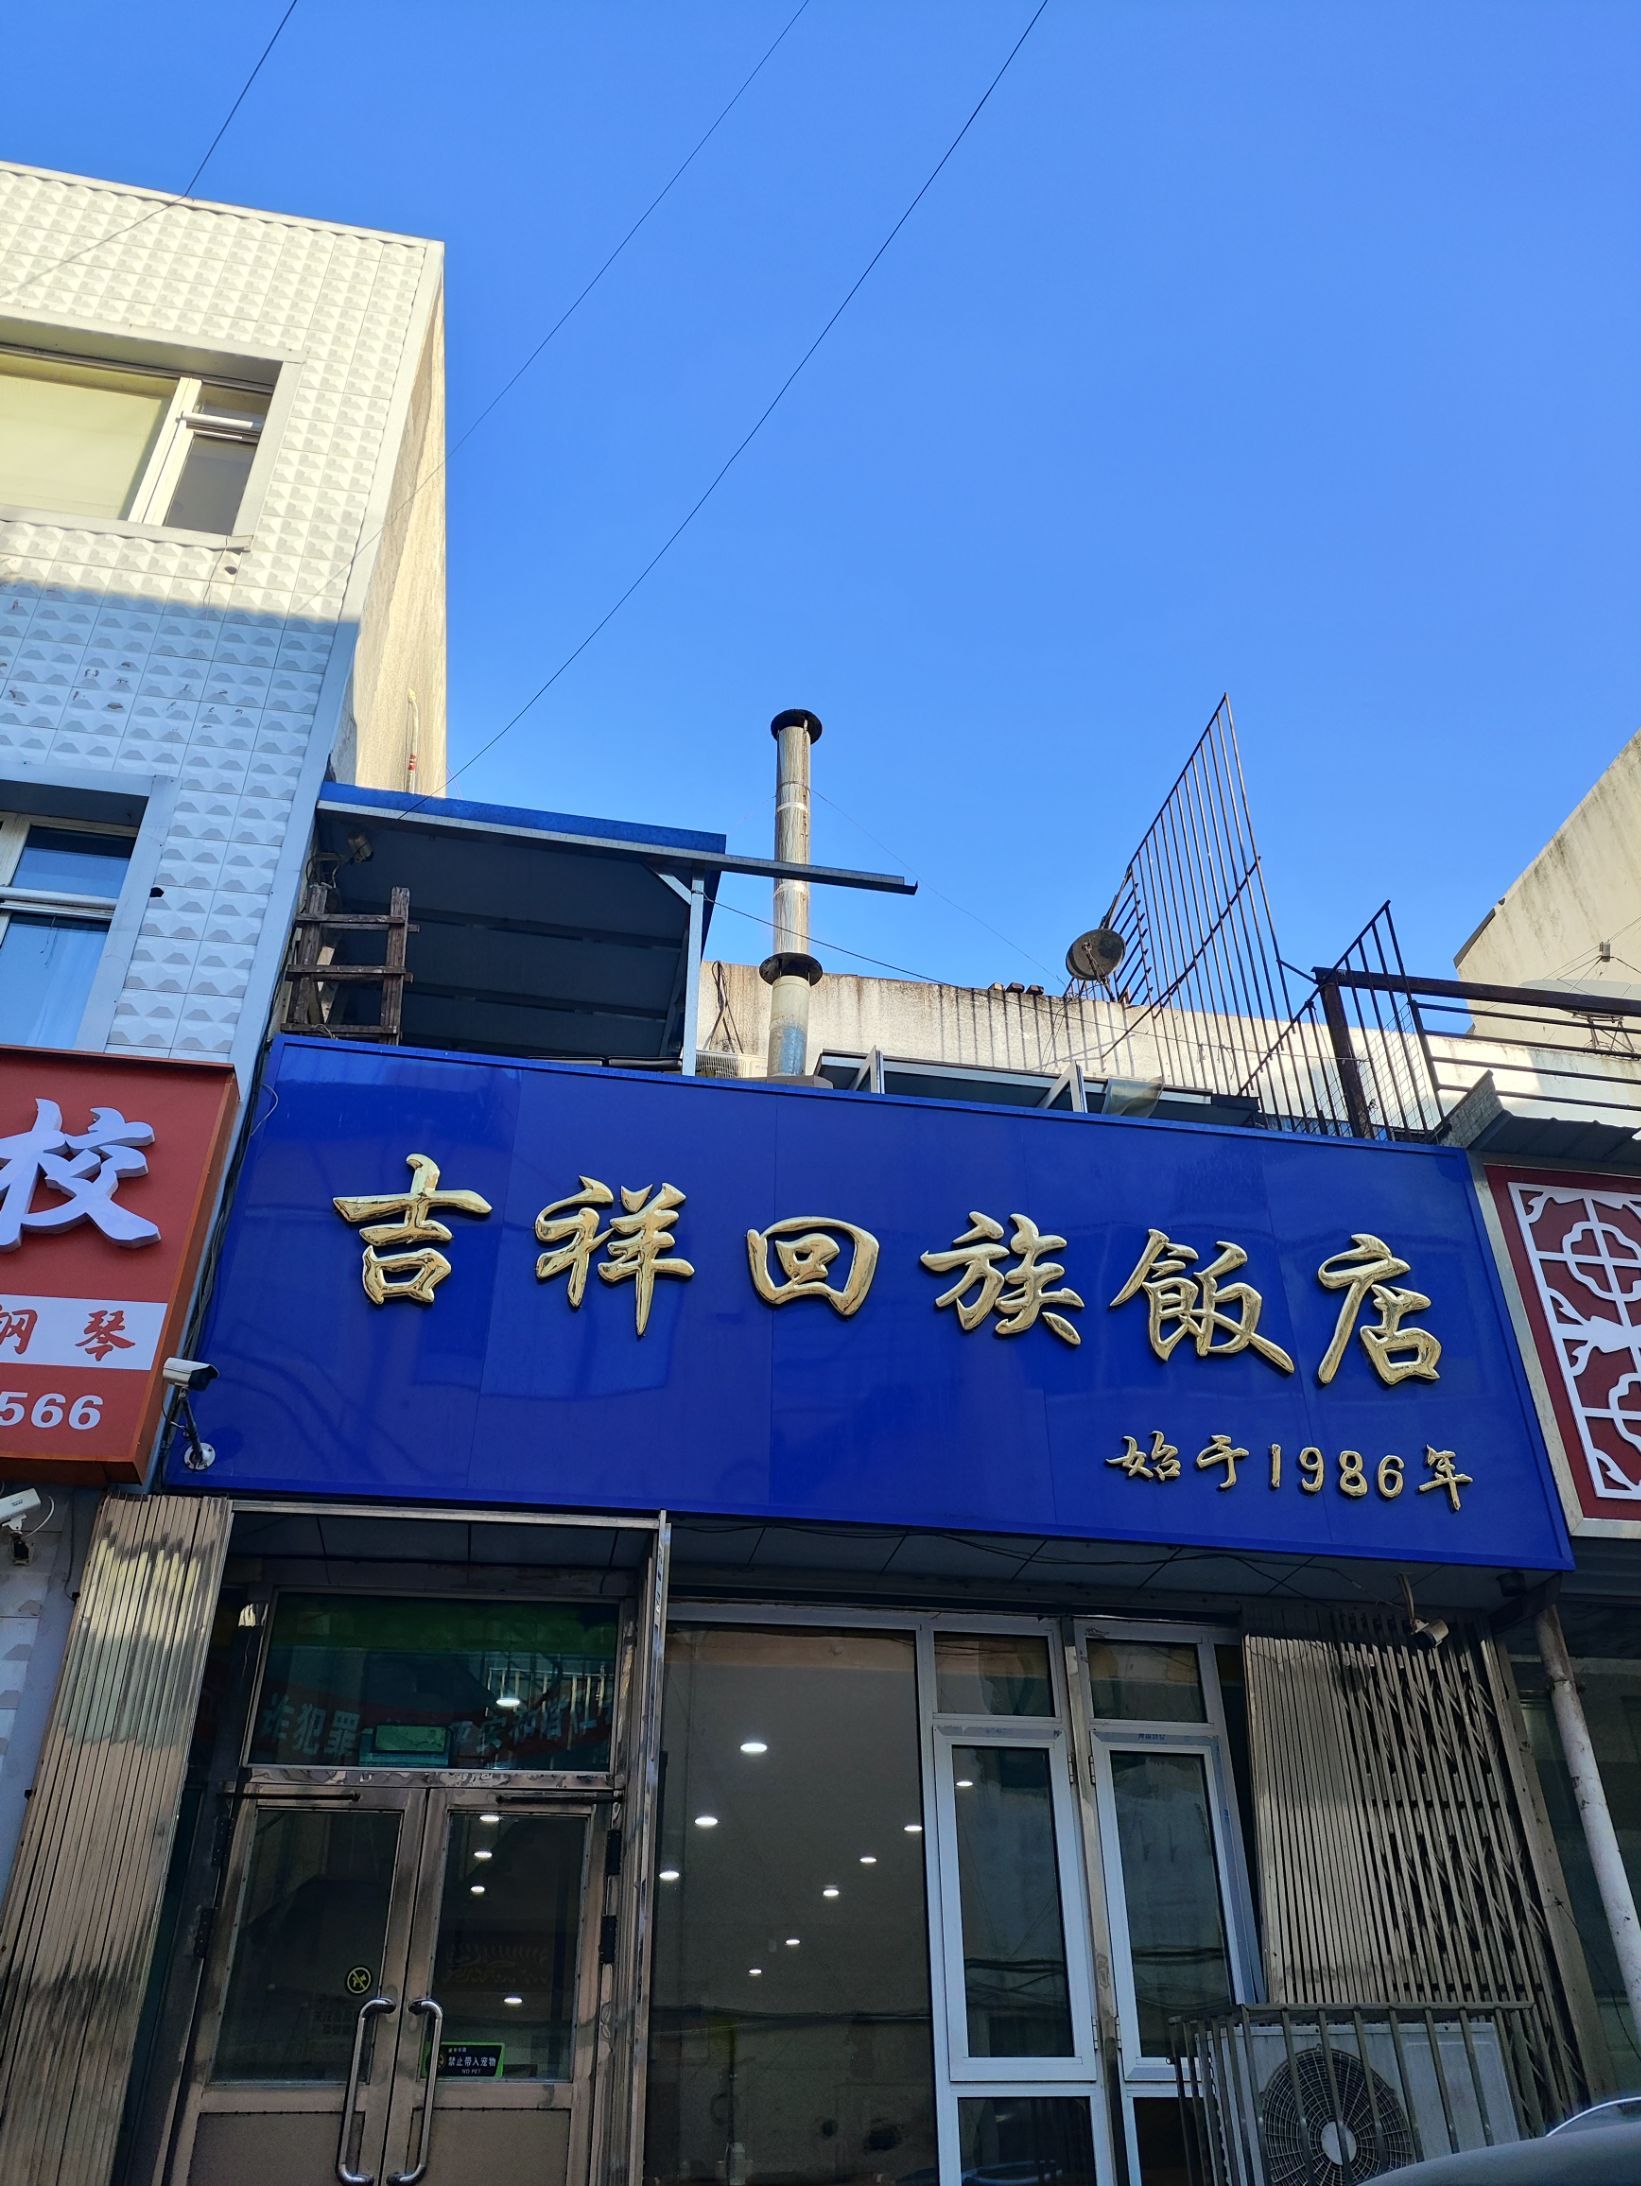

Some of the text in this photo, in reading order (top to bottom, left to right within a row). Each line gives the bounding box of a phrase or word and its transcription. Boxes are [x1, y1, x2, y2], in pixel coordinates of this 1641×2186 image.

[0, 1098, 161, 1252] 校
[333, 1153, 1443, 1385] 吉祥回族飯店
[1106, 1430, 1473, 1512] 始于1986年
